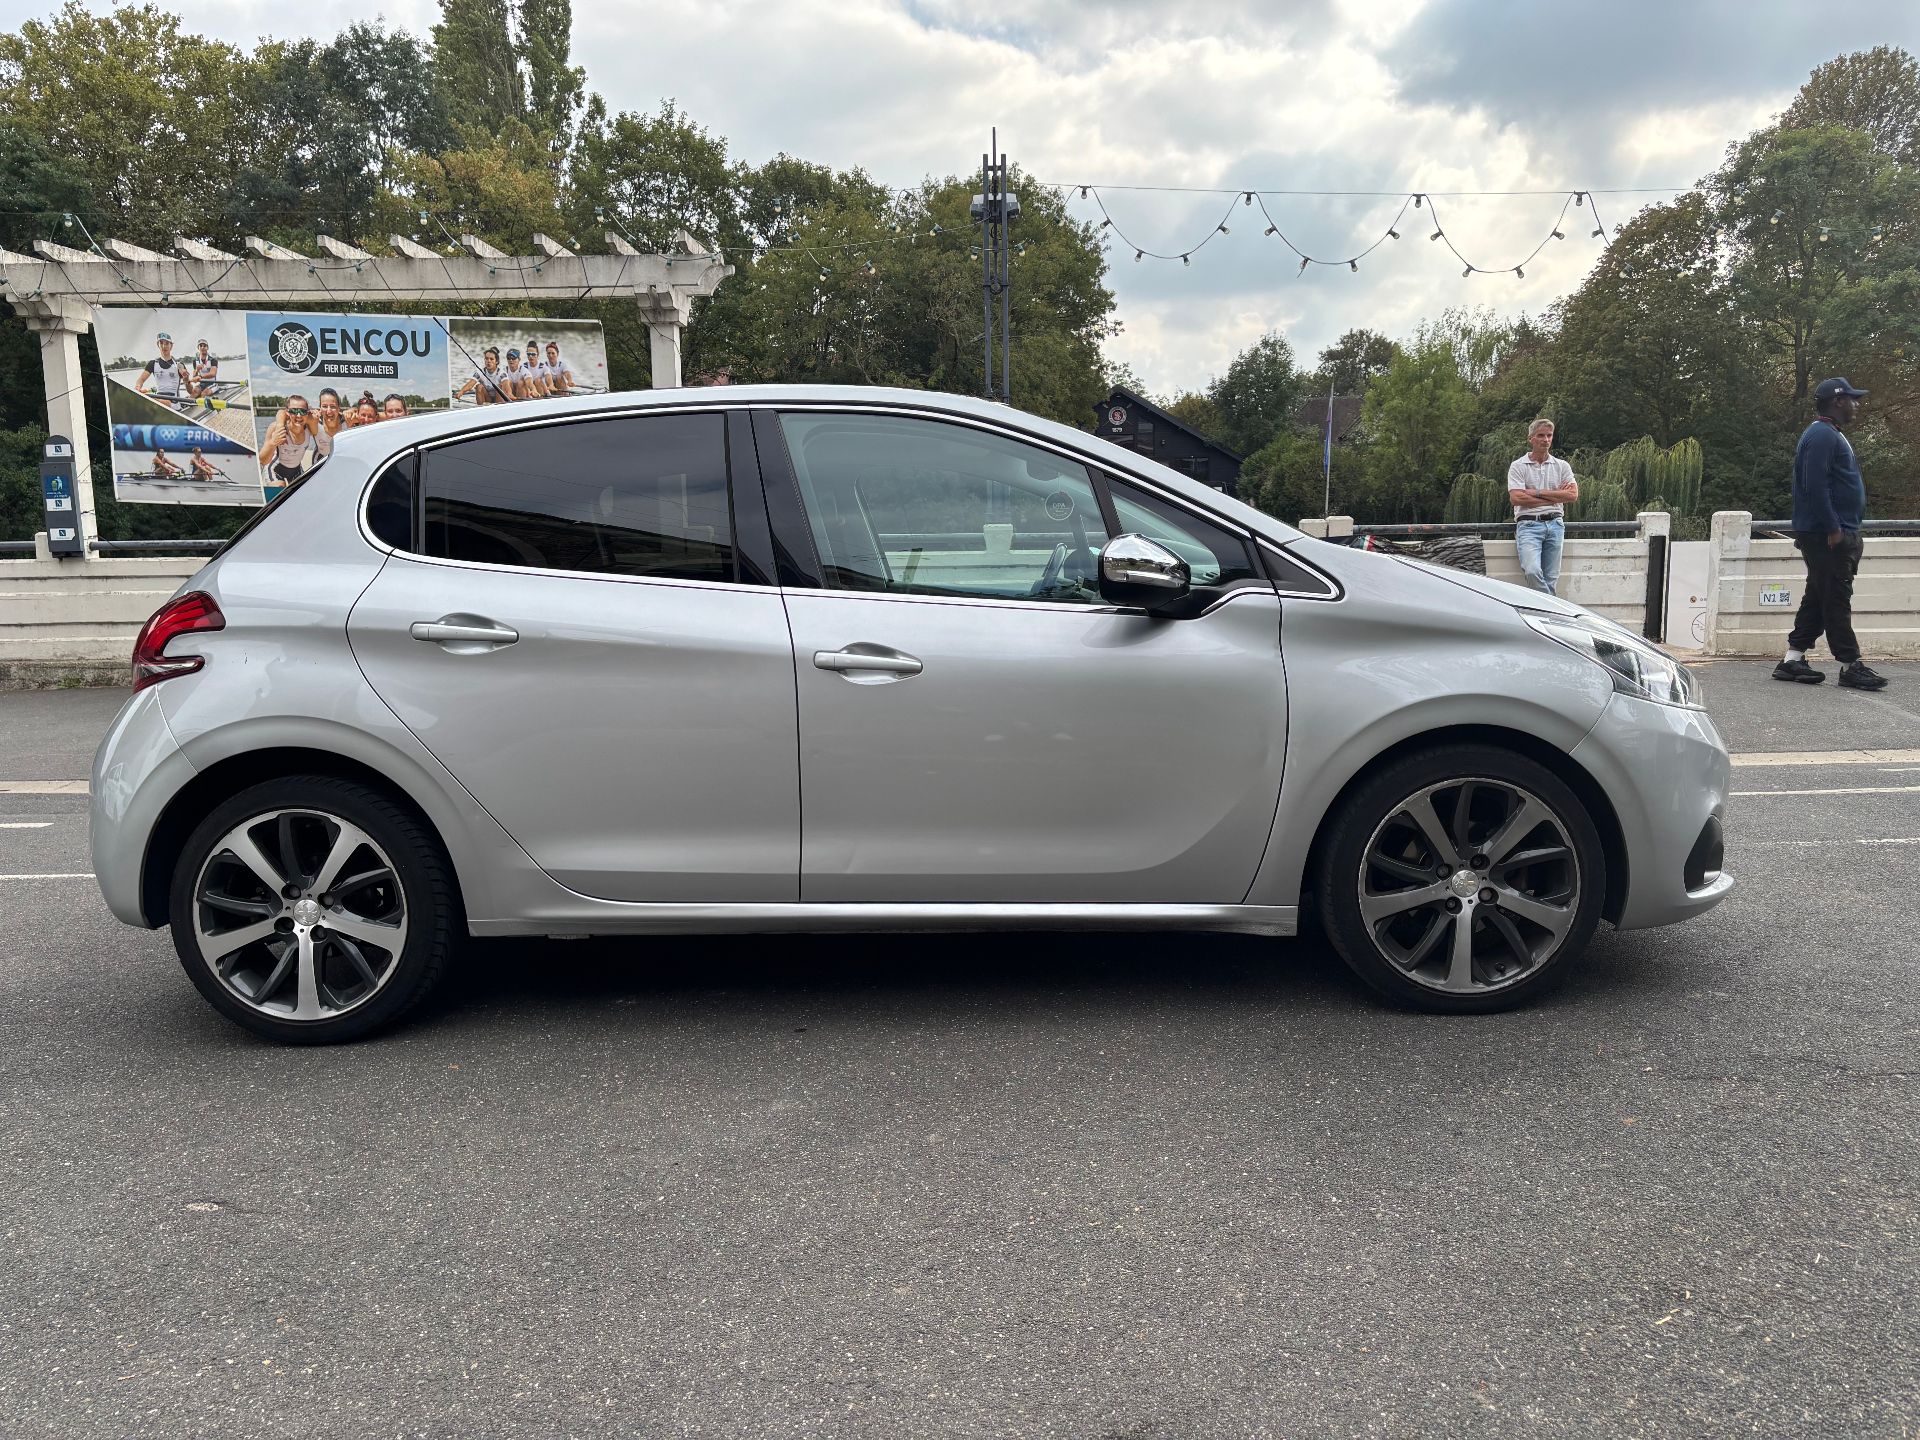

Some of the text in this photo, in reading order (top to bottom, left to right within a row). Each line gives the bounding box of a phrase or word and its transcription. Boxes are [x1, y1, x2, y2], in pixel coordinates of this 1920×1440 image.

[320, 328, 431, 357] ENCOU
[324, 364, 394, 375] FIER DE SES ATHLÈTES
[187, 430, 222, 442] PARIS
[1763, 593, 1777, 603] N1
